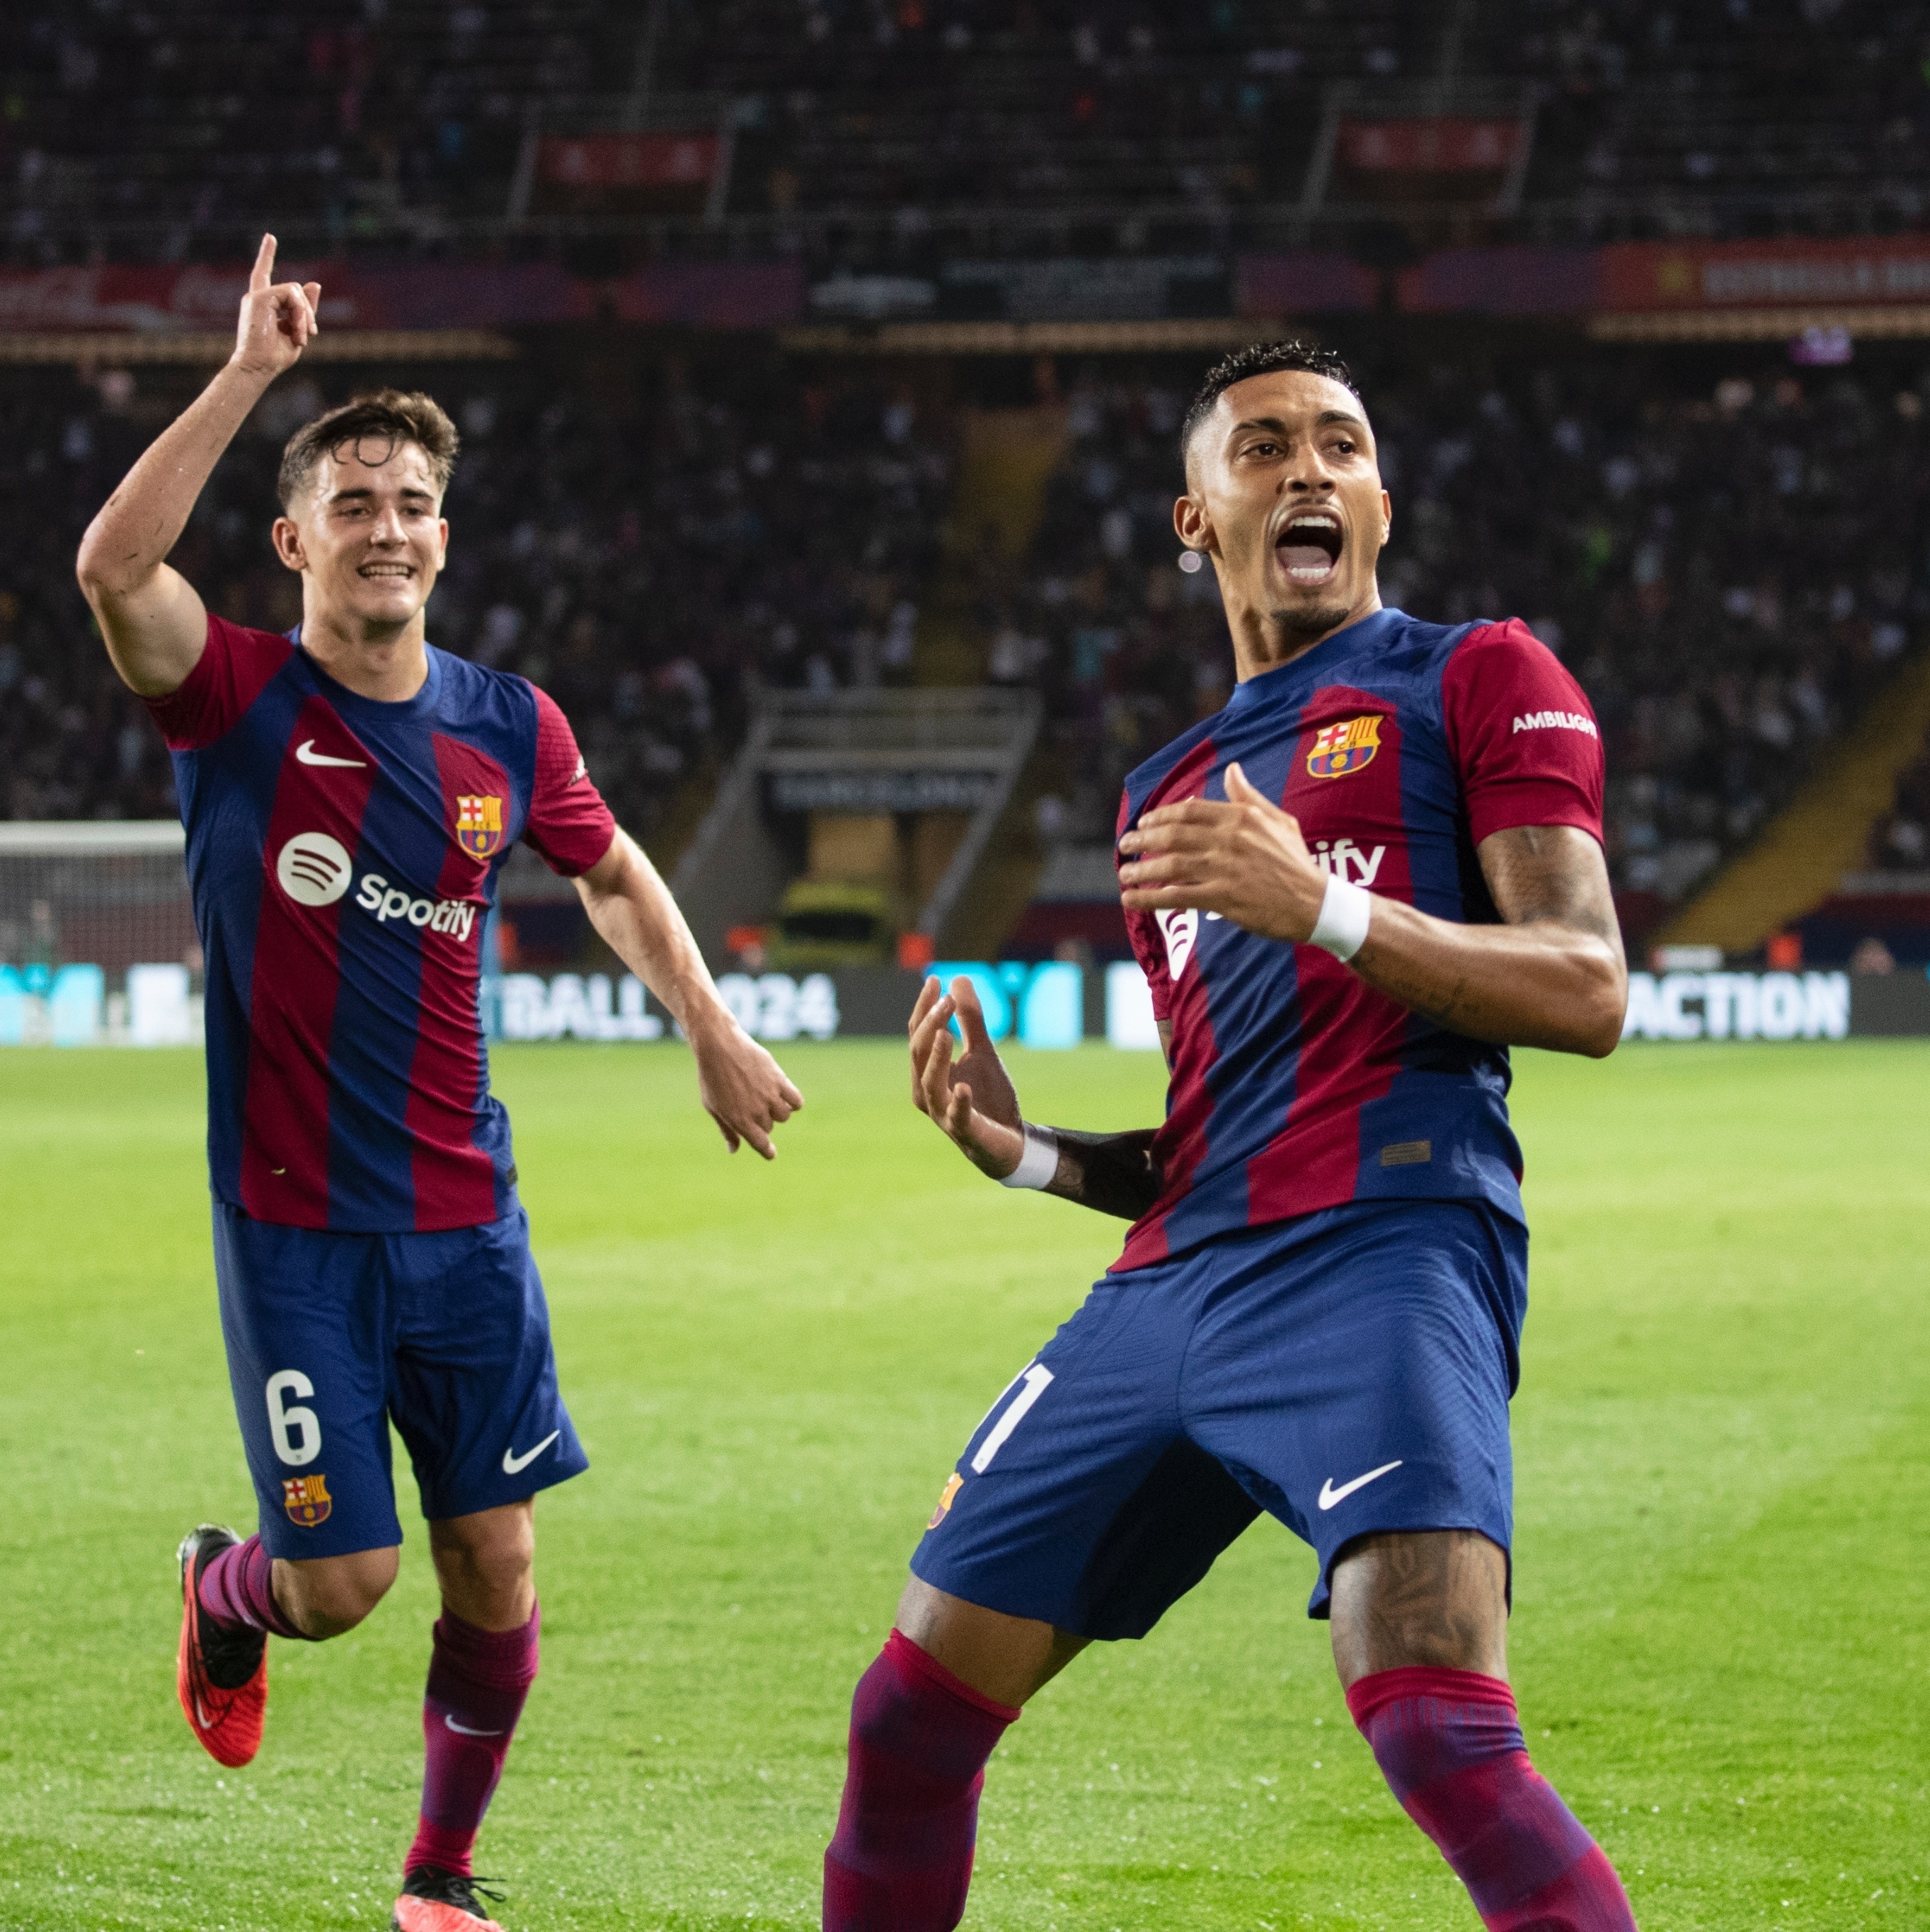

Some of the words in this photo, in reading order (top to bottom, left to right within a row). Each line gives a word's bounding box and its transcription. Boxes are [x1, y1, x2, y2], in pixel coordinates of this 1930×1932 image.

[1512, 711, 1597, 740] AMBILIGH
[355, 873, 476, 943] Spotify
[480, 972, 664, 1040] BALL
[672, 972, 840, 1040] 024
[265, 1369, 322, 1466] 6
[963, 1357, 1056, 1475] 1
